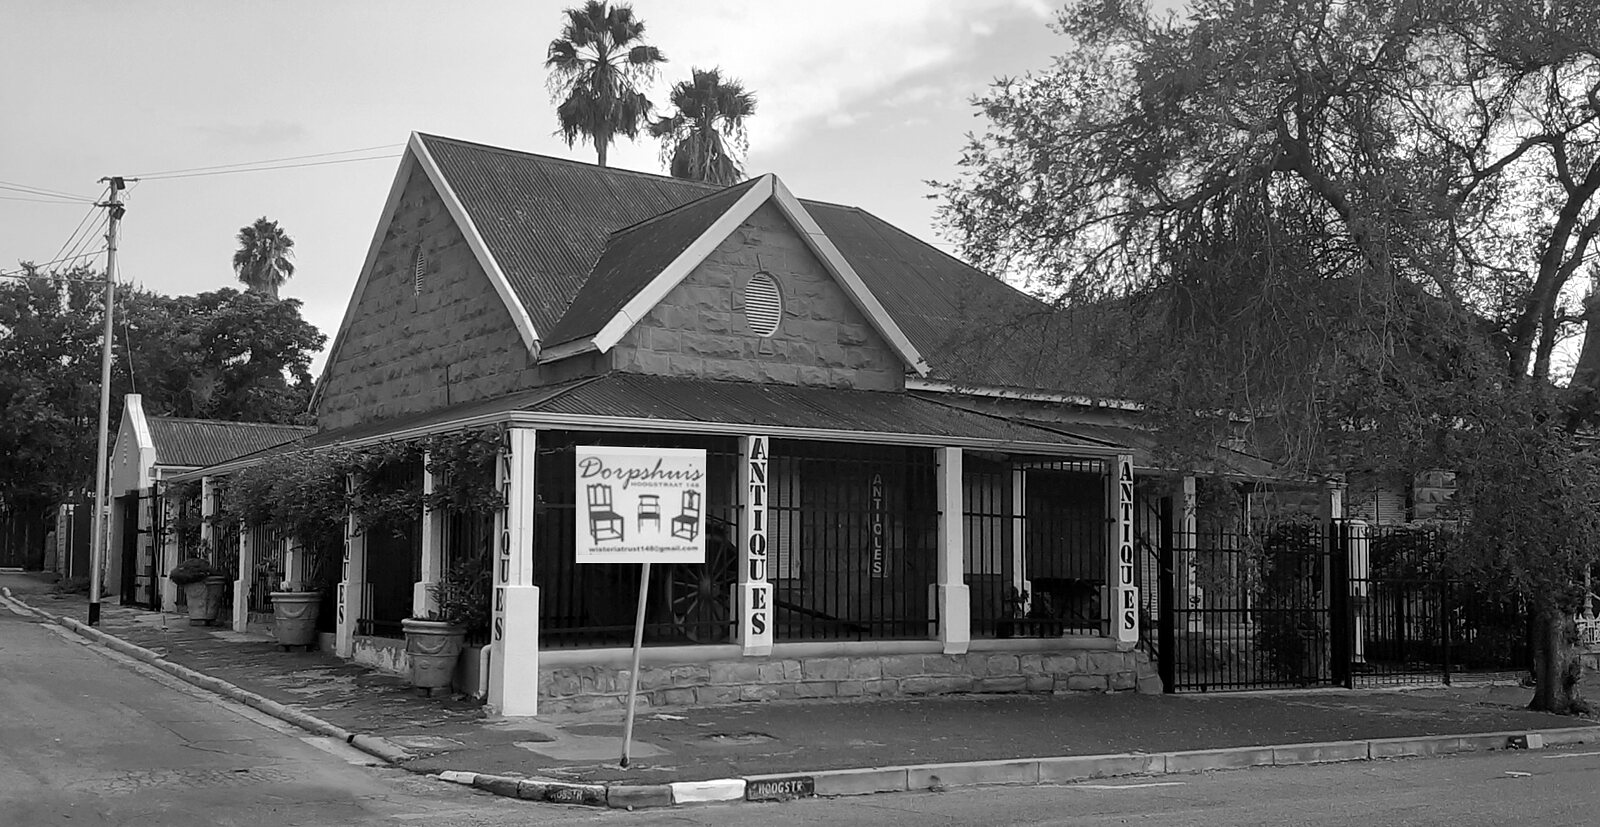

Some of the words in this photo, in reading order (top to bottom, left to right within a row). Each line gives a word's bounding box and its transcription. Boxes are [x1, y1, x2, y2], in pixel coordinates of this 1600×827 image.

[338, 473, 354, 625] NIQUES
[578, 456, 704, 490] Dorpshuis
[749, 437, 766, 635] ANTIQUES
[1120, 461, 1135, 630] ANTIQUES
